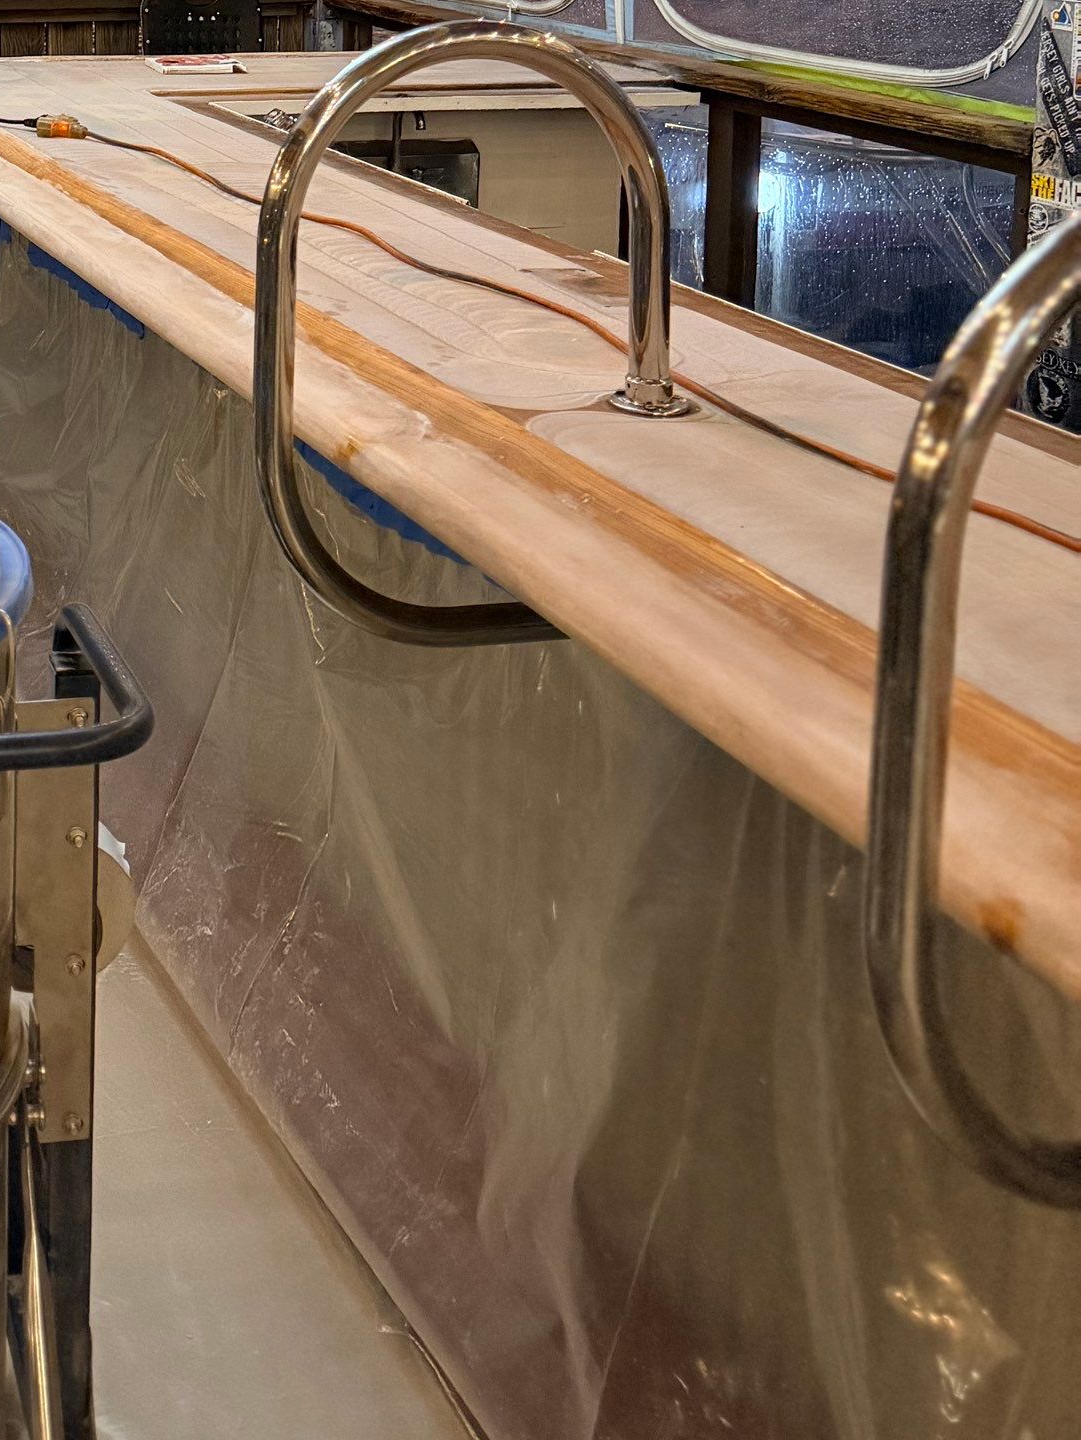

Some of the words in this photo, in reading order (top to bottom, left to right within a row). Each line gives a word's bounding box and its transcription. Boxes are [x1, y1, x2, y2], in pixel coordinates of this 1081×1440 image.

[1041, 30, 1059, 63] JERSEY
[1052, 64, 1070, 95] GIRLS
[1040, 77, 1057, 102] GETS
[1049, 103, 1070, 139] PICKED
[1031, 175, 1056, 189] SKI
[1031, 187, 1055, 200] THE
